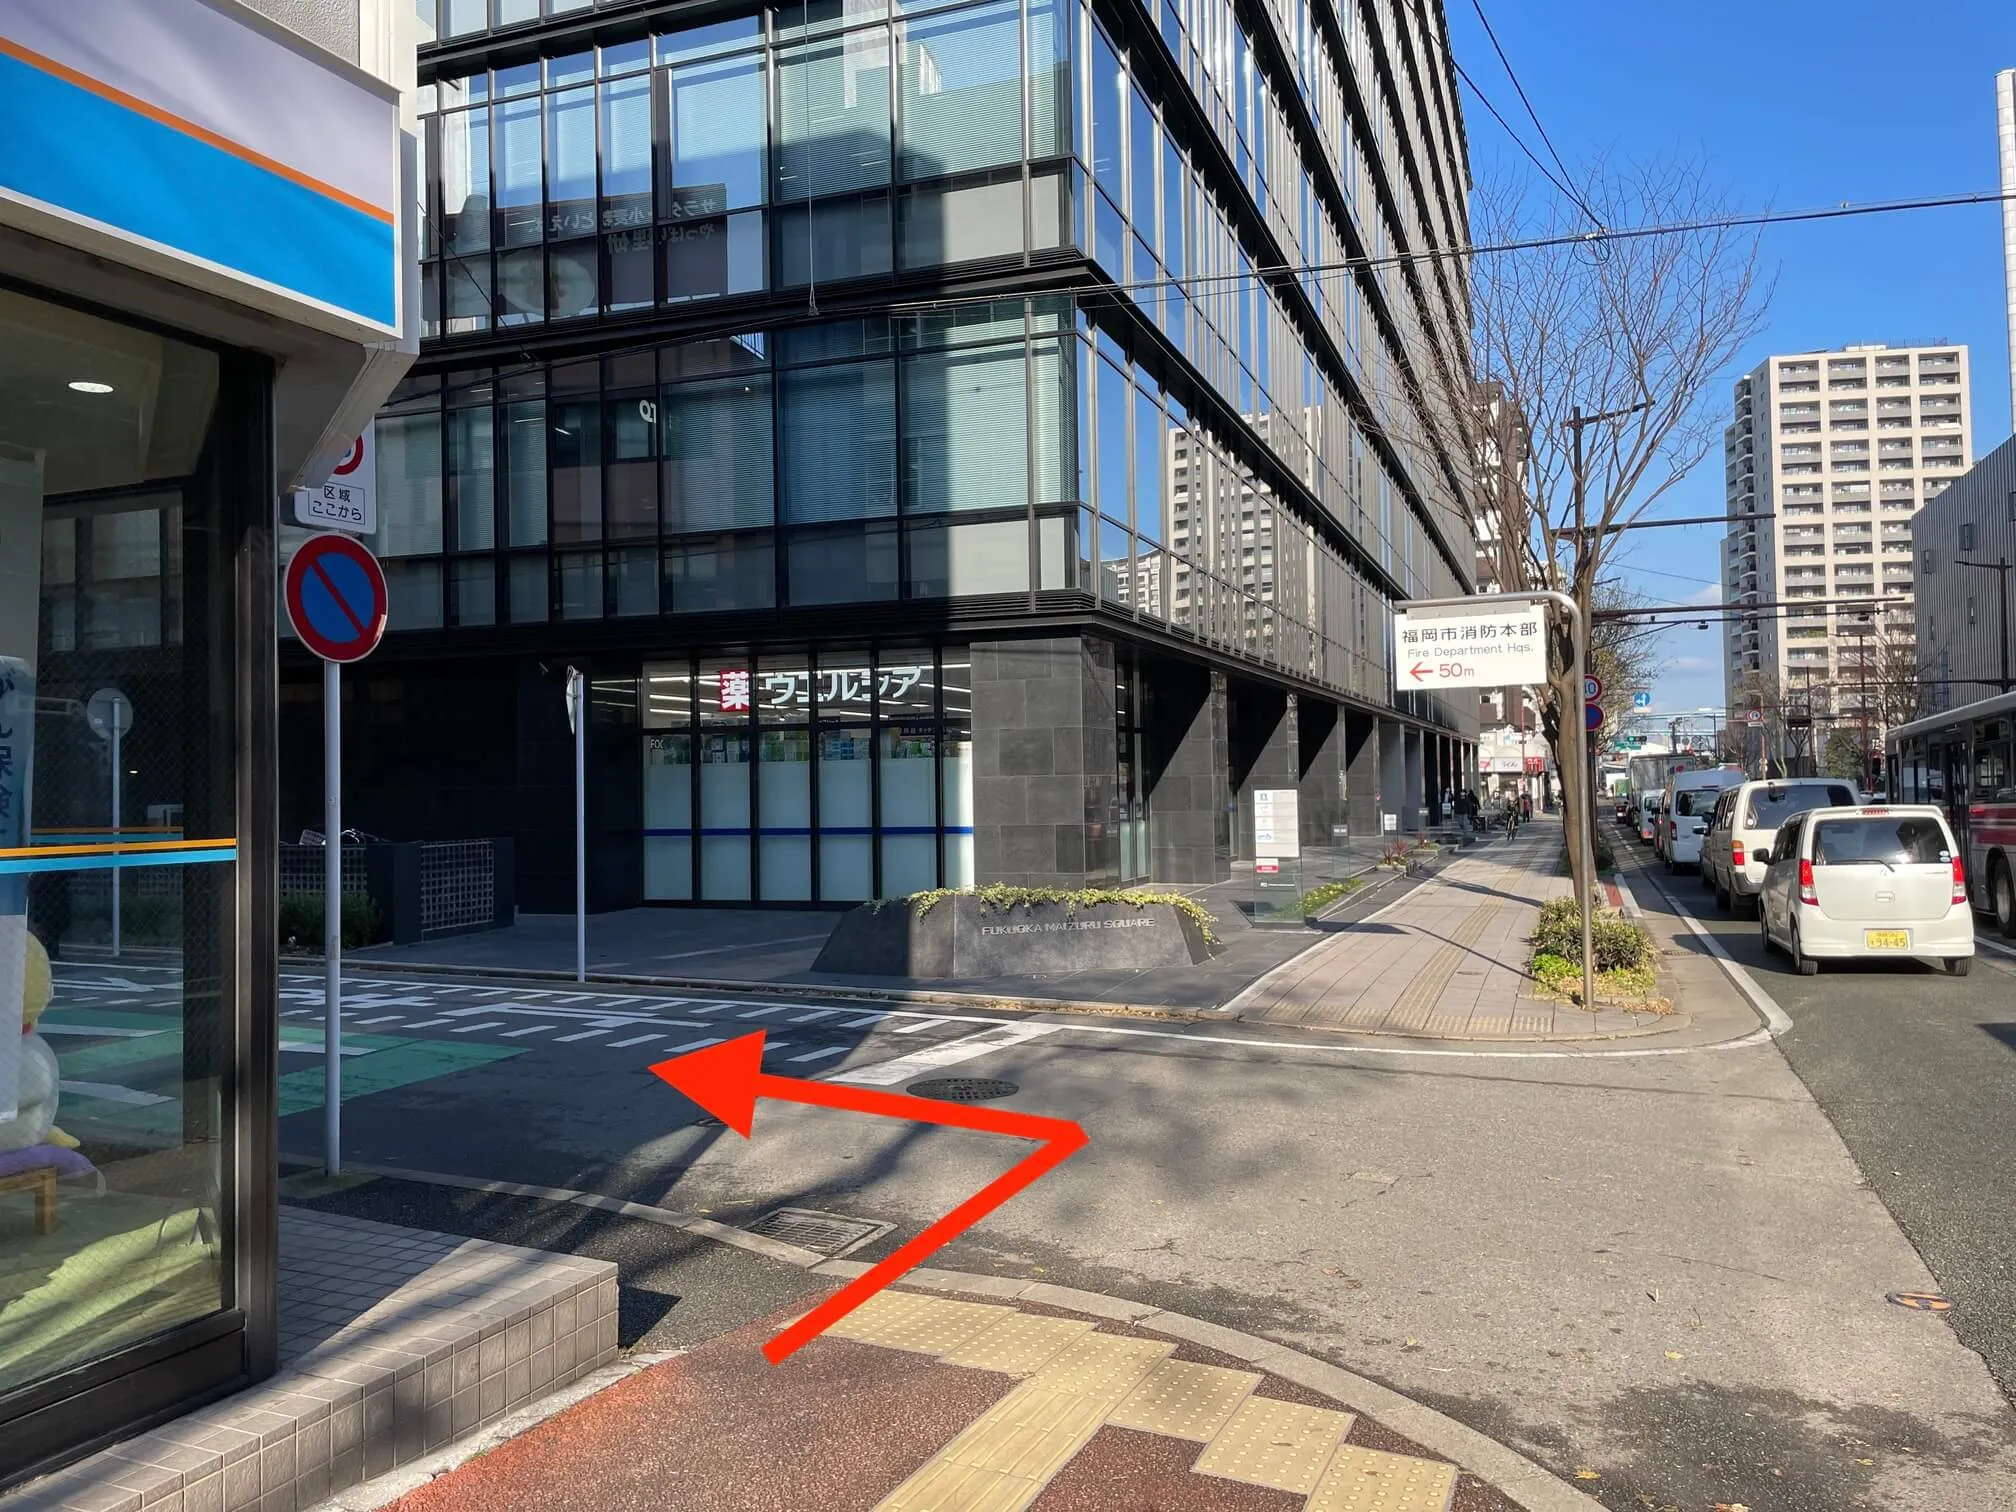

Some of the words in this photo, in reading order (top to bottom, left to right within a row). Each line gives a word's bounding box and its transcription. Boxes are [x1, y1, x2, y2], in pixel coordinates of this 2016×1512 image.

[324, 485, 351, 502] 区域
[312, 500, 362, 520] ここから
[1402, 622, 1538, 644] 福岡市消防本部
[1407, 648, 1430, 659] Fire
[1434, 645, 1503, 659] Department
[1507, 643, 1535, 655] Hqs.
[1438, 662, 1475, 679] 50m
[721, 670, 750, 710] 薬
[981, 923, 1042, 936] FUKUOKA
[1045, 920, 1101, 932] MAIZURU
[1103, 918, 1156, 929] SQUARE
